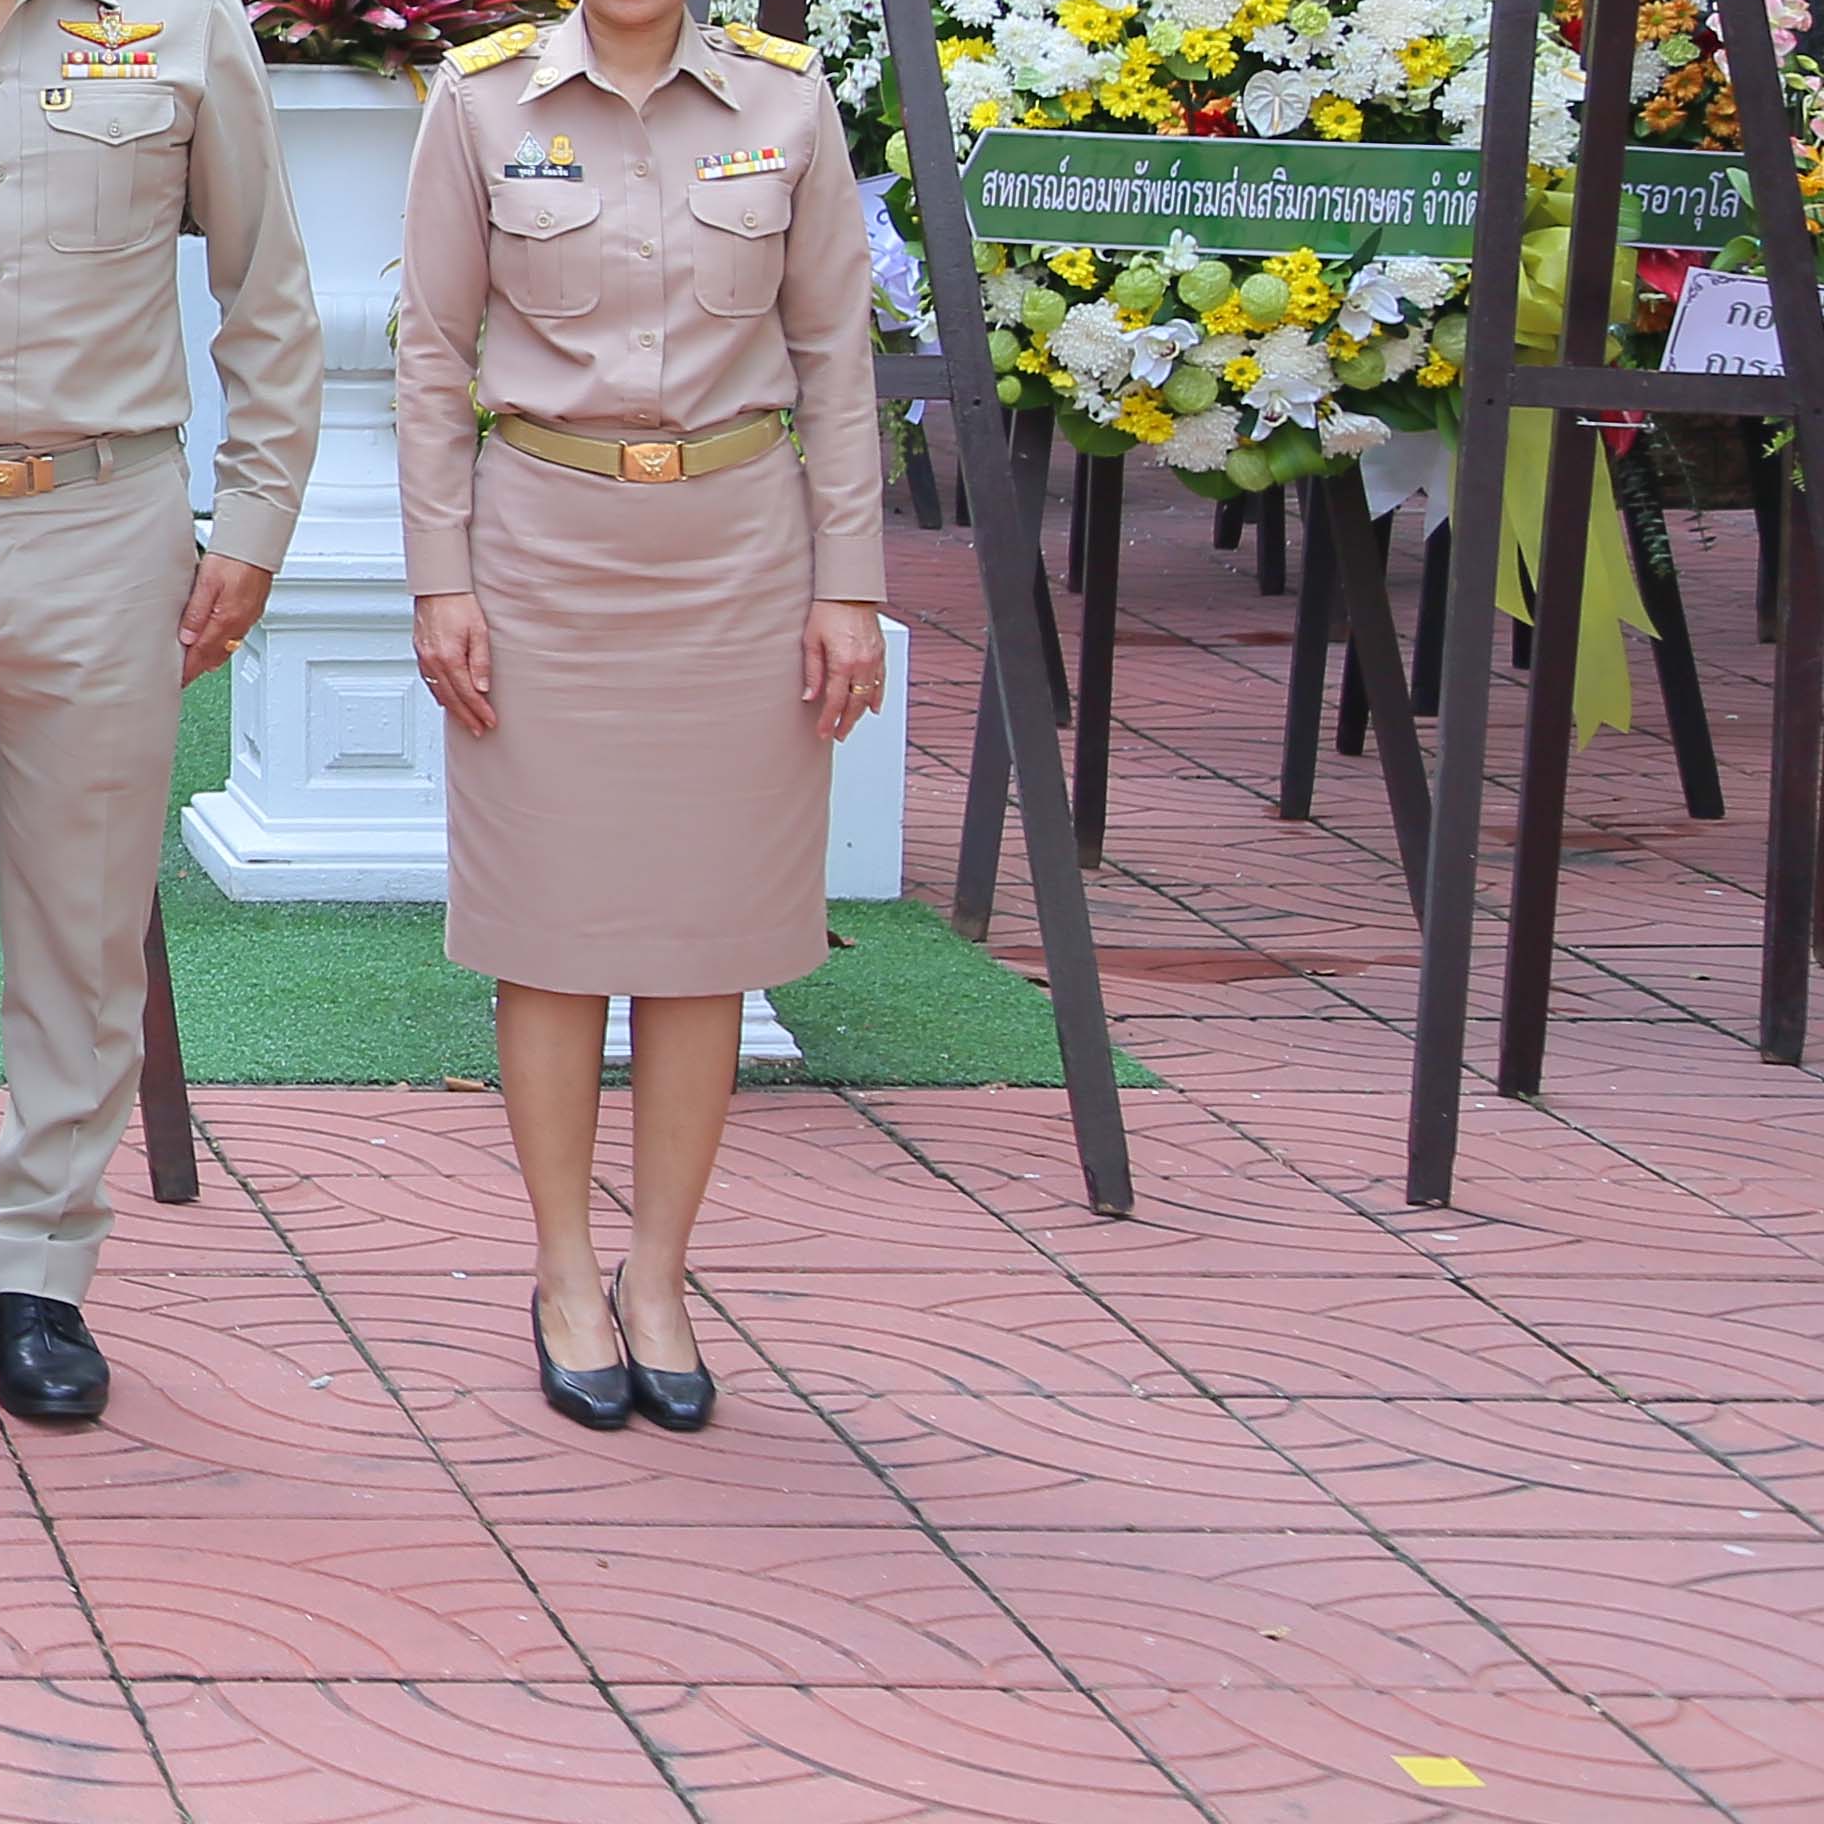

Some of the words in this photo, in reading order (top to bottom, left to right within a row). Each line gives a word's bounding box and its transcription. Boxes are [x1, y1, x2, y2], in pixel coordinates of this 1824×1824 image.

[981, 156, 1416, 226] สหกรณ์ออมทรัพย์กรมส่งเสริมการเกษตร
